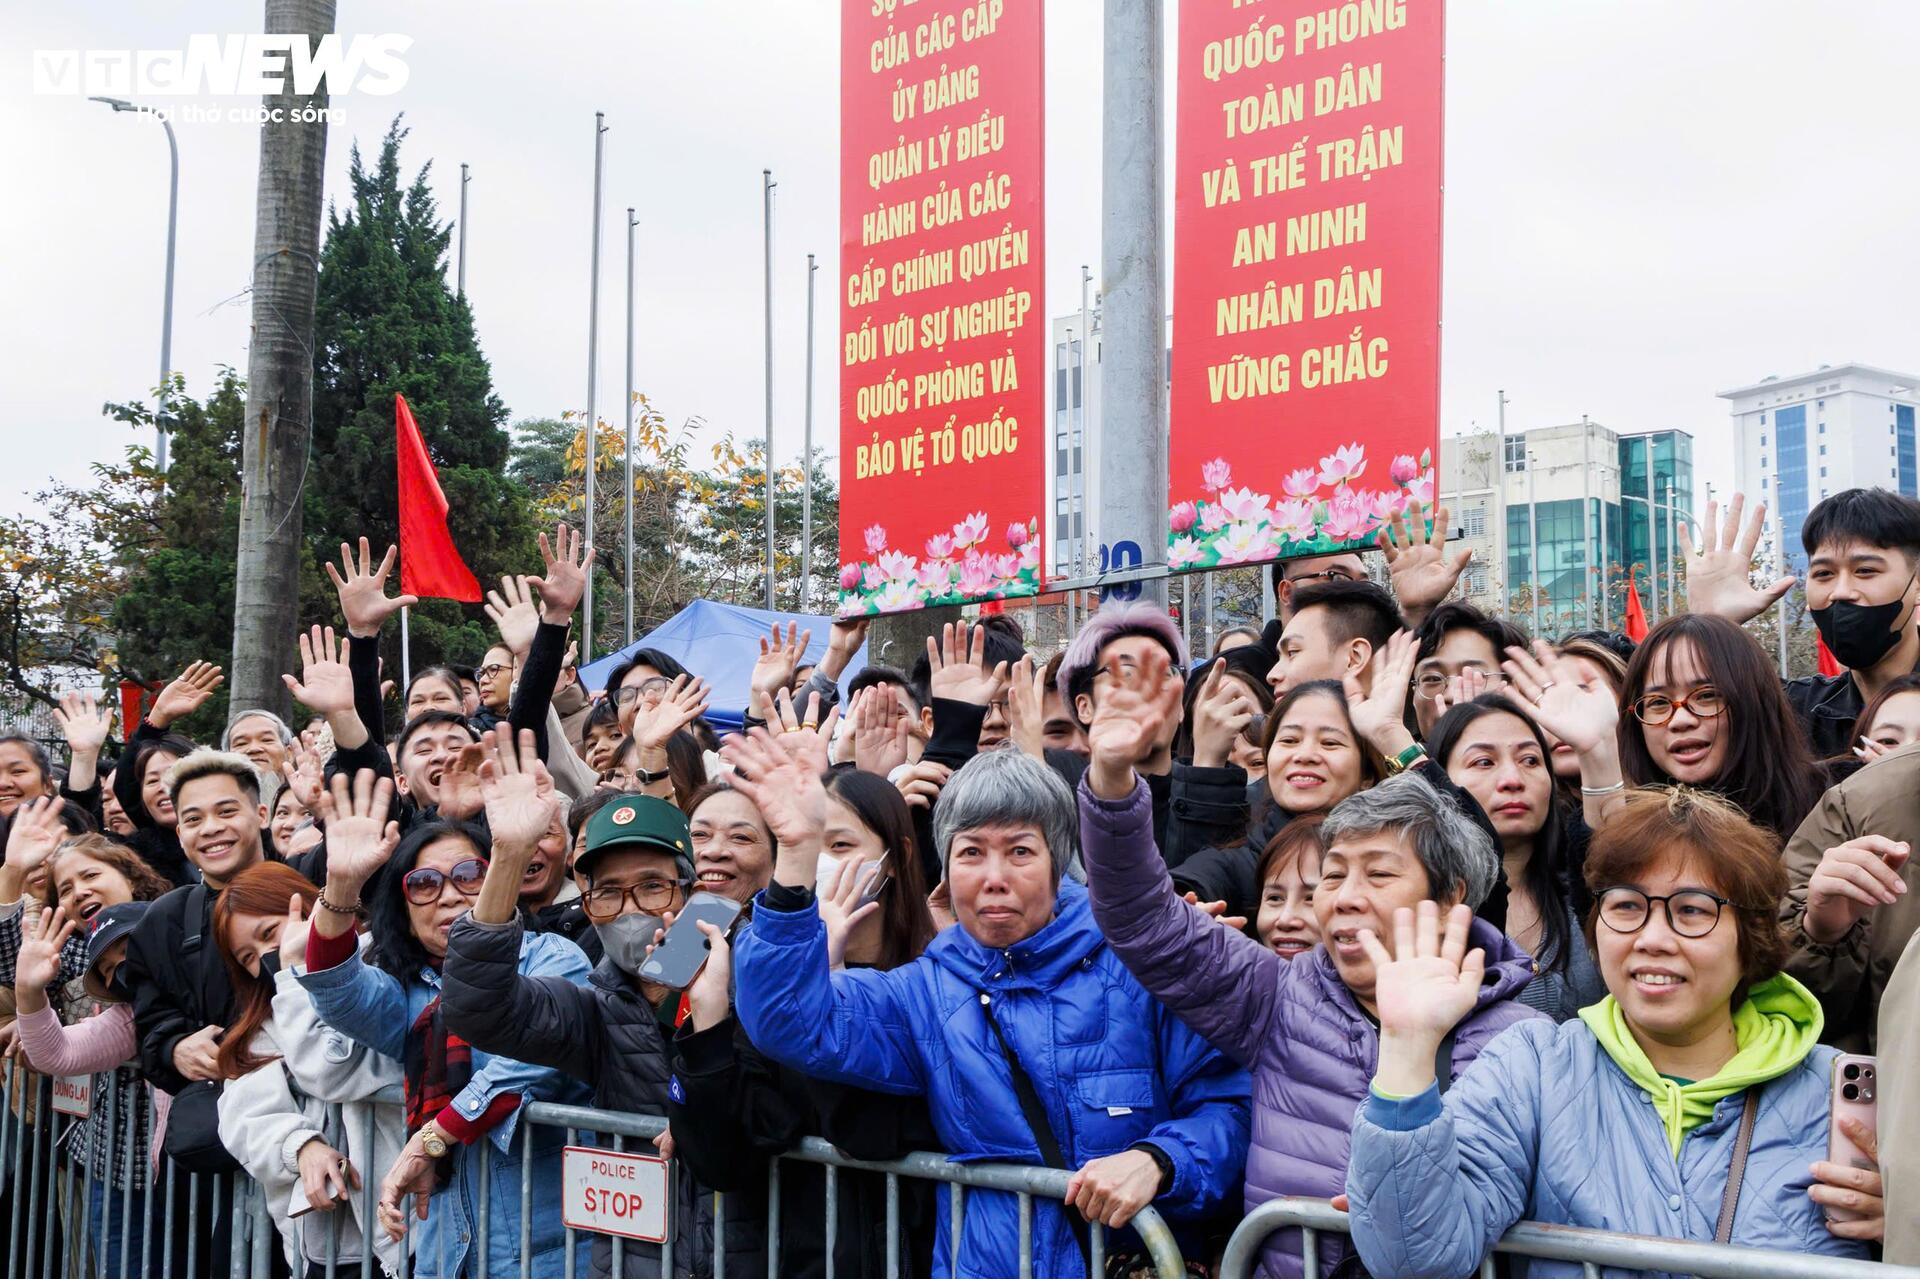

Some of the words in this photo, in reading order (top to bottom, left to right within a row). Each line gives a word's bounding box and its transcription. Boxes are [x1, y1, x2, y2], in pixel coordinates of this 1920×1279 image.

[870, 24, 910, 74] CỦA
[915, 12, 956, 59] CÁC
[1203, 14, 1285, 83] QUỐC
[892, 78, 918, 124] ỦY
[922, 63, 980, 114] ĐẢNG
[1222, 82, 1304, 139] TOÀN
[1314, 62, 1382, 117] DÂN
[868, 134, 923, 191] QUẢN
[928, 124, 952, 171] LÝ
[956, 108, 1005, 162] ĐIỀU
[1201, 158, 1241, 209] VÀ
[1249, 135, 1310, 198] THẾ
[1316, 124, 1404, 182] TRẬN
[862, 200, 916, 247] HÀNH
[921, 180, 963, 230] CỦA
[968, 170, 1011, 218] CÁC
[1232, 221, 1277, 268] AN
[1286, 202, 1367, 257] NINH
[847, 257, 886, 308] CẤP
[891, 249, 953, 297] CHÍNH
[959, 222, 1029, 283] QUYỀN
[1216, 280, 1304, 337] NHÂN
[1313, 265, 1382, 319] DÂN
[844, 316, 877, 366] ĐỐI
[882, 312, 915, 357] VỚI
[920, 305, 950, 353] SỰ
[953, 286, 1031, 338] NGHIỆP
[856, 368, 909, 424] QUỐC
[914, 360, 984, 409] PHÒNG
[990, 348, 1018, 394] VÀ
[1207, 353, 1290, 404] VỮNG
[1300, 325, 1389, 389] CHẮC
[856, 431, 895, 480] BẢO
[900, 427, 925, 477] VỆ
[930, 414, 957, 466] TỔ
[961, 406, 1018, 464] QUỐC
[584, 1187, 642, 1219] STOP
[591, 1160, 635, 1179] POLICE
